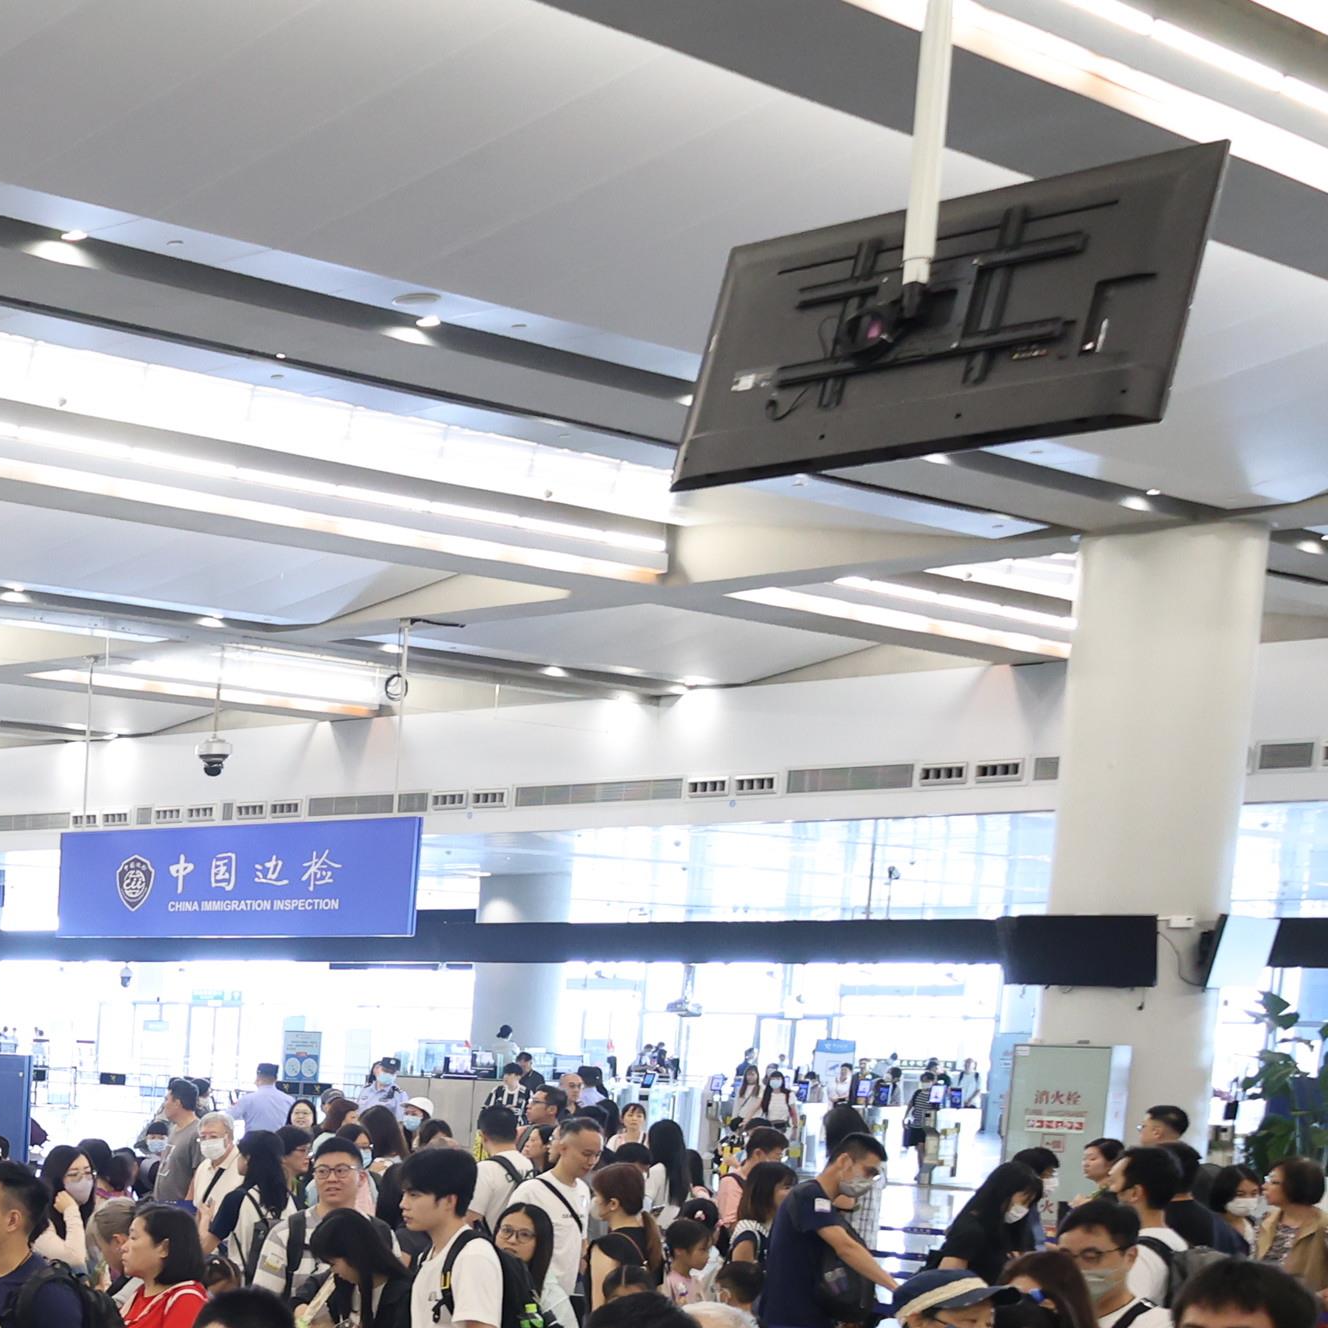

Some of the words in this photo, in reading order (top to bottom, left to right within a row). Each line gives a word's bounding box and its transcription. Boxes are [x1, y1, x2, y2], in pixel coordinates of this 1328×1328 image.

[168, 849, 342, 894] 中国边检
[168, 901, 199, 912] CHINA
[200, 899, 271, 911] IMMIGRATION
[273, 898, 339, 911] INSPECTION
[1035, 1090, 1081, 1105] 消火栓
